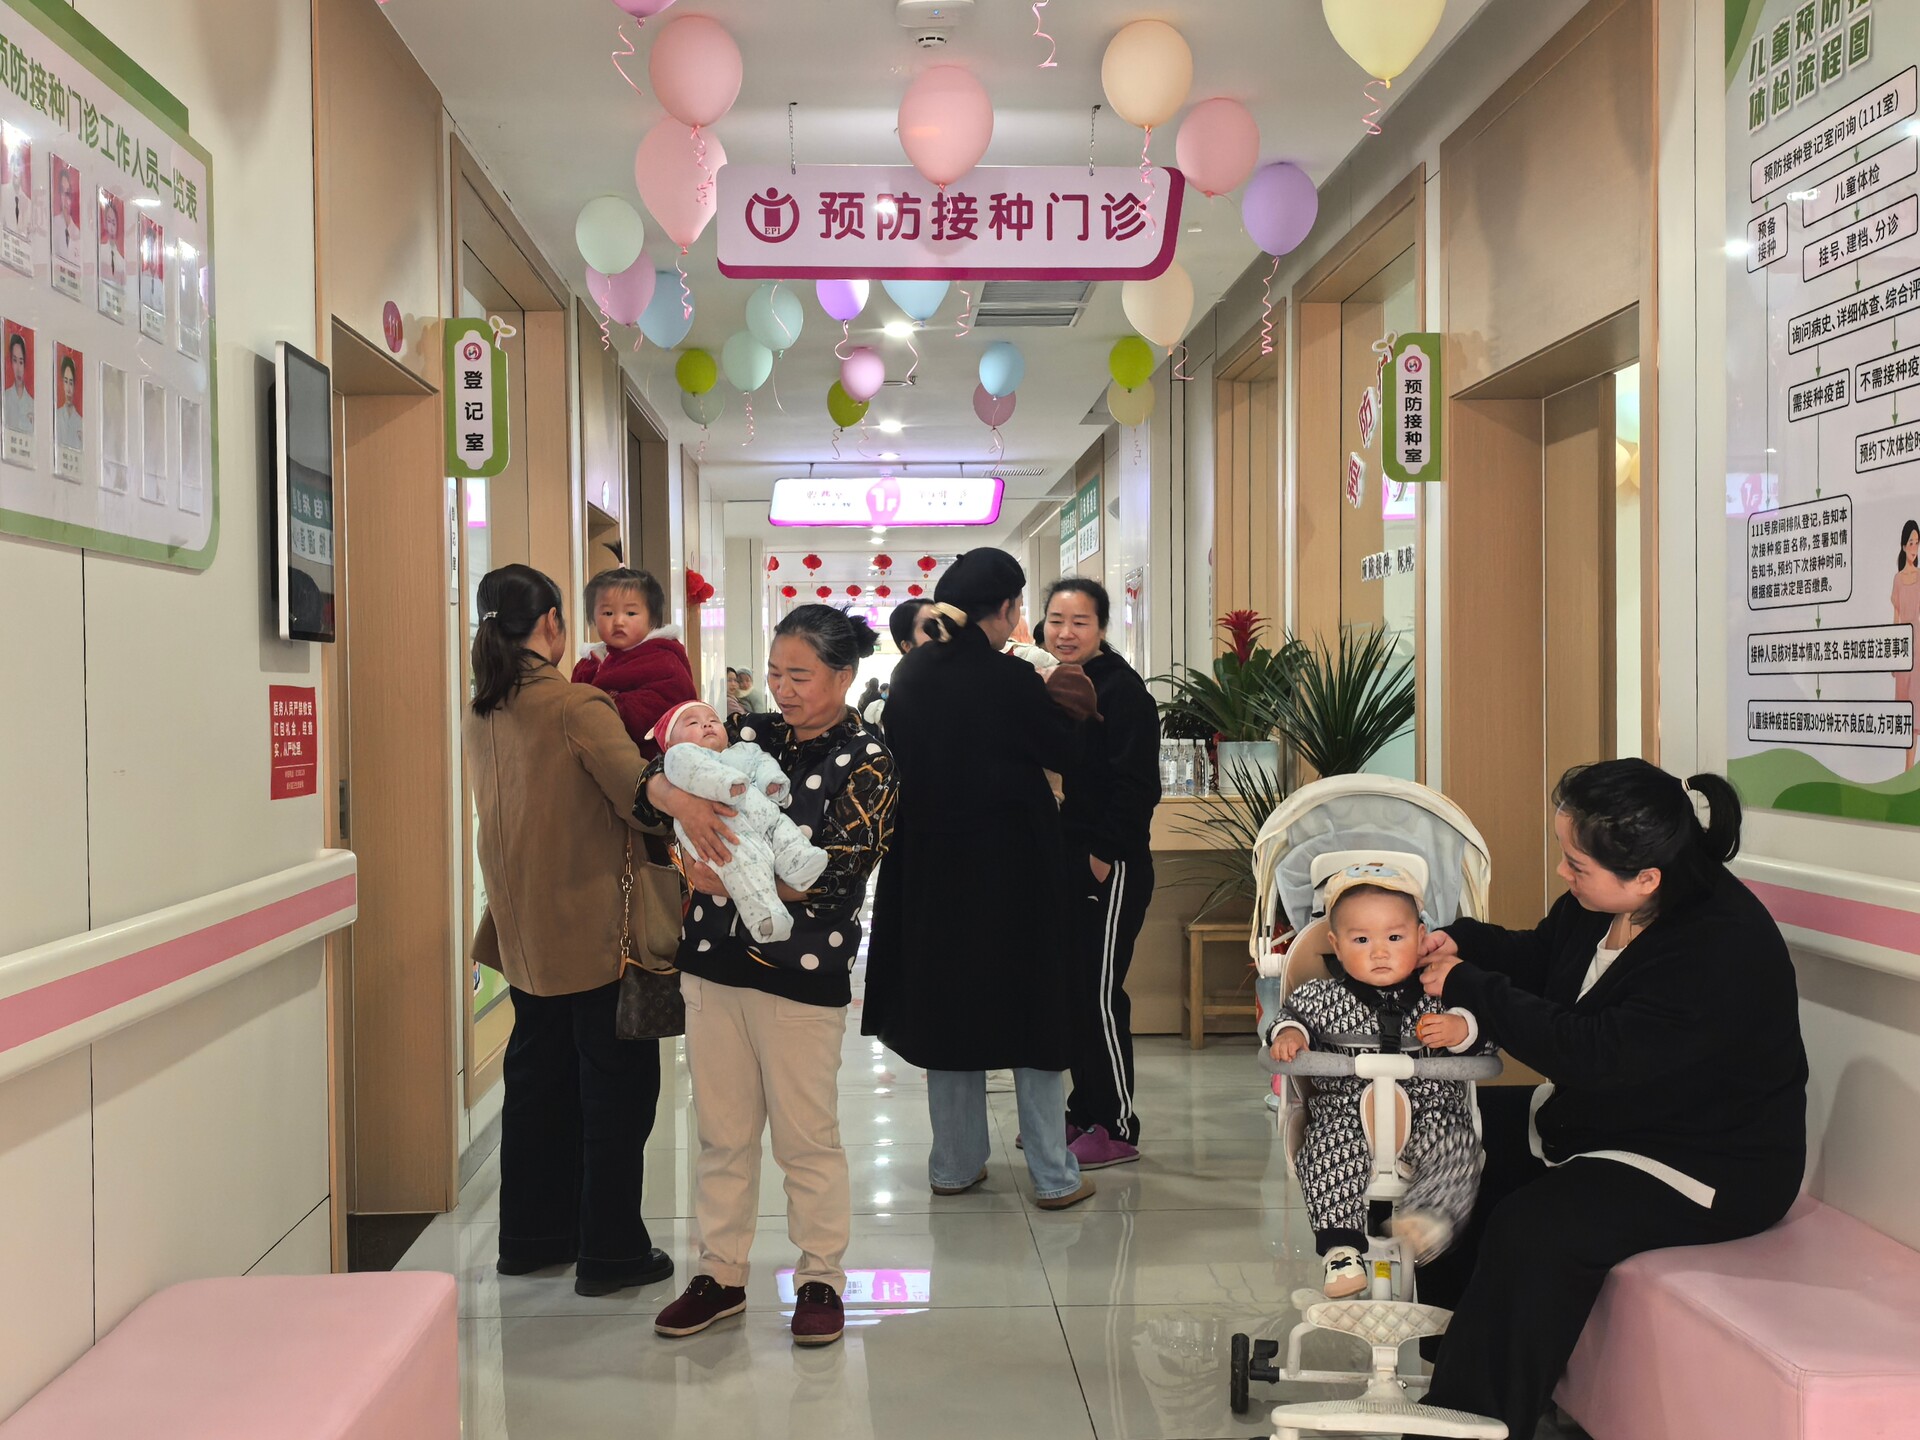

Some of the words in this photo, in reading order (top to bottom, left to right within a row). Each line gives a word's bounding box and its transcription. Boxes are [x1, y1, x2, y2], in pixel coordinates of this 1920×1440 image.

[1749, 15, 1870, 130] 体检流程图
[1763, 89, 1899, 184] 预防接种登记室问询(111室)
[1834, 163, 1880, 203] 儿童体检
[764, 227, 781, 235] EPI
[818, 191, 1148, 241] 预防接种门诊
[1757, 217, 1776, 239] 预备
[1818, 213, 1899, 267] 挂号、建档、分诊
[1757, 240, 1776, 263] 接种
[464, 370, 484, 451] 登记室
[1404, 379, 1423, 463] 预防接种室
[1792, 379, 1846, 413] 需接种疫苗
